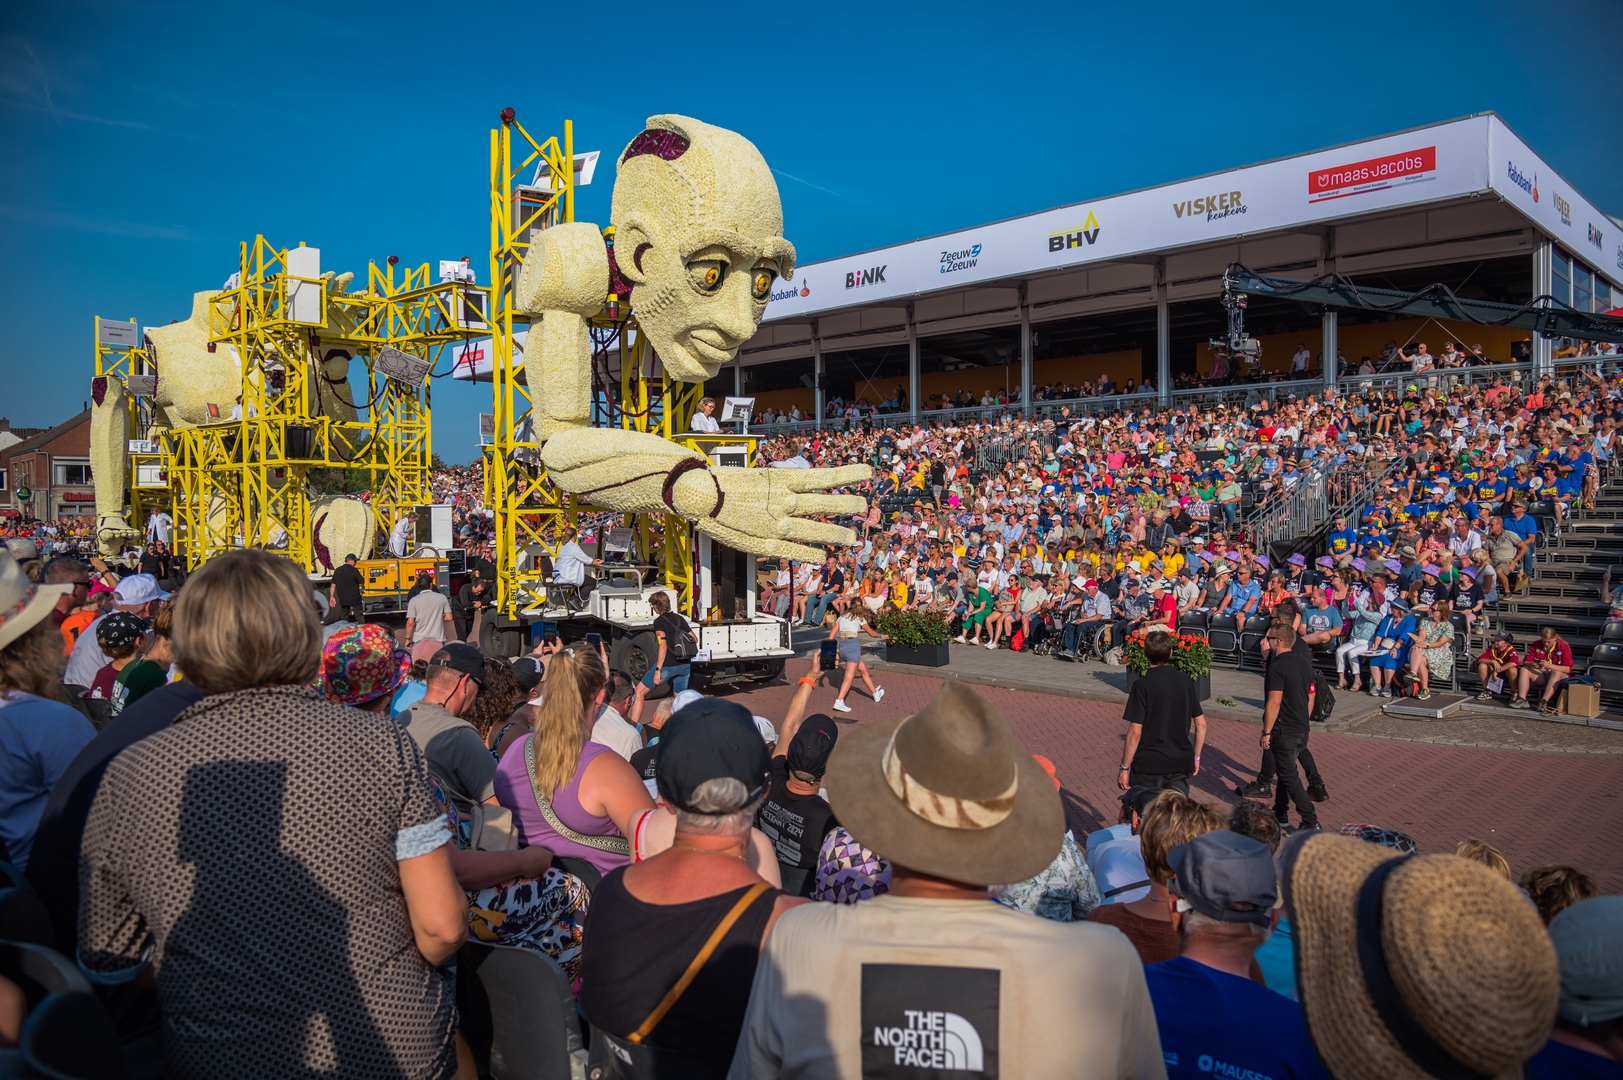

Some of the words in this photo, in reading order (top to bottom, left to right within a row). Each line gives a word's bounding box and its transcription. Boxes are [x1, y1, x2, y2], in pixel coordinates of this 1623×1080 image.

[1507, 160, 1532, 196] Rabobank
[1173, 191, 1242, 218] VISKER
[1207, 204, 1248, 222] keukens
[1049, 228, 1100, 252] BHV
[940, 251, 971, 263] Zeeuw
[769, 287, 798, 302] bobank
[786, 823, 804, 838] 2024
[904, 1010, 944, 1030] THE
[874, 1026, 944, 1050] NORTH
[894, 1047, 944, 1069] FACE
